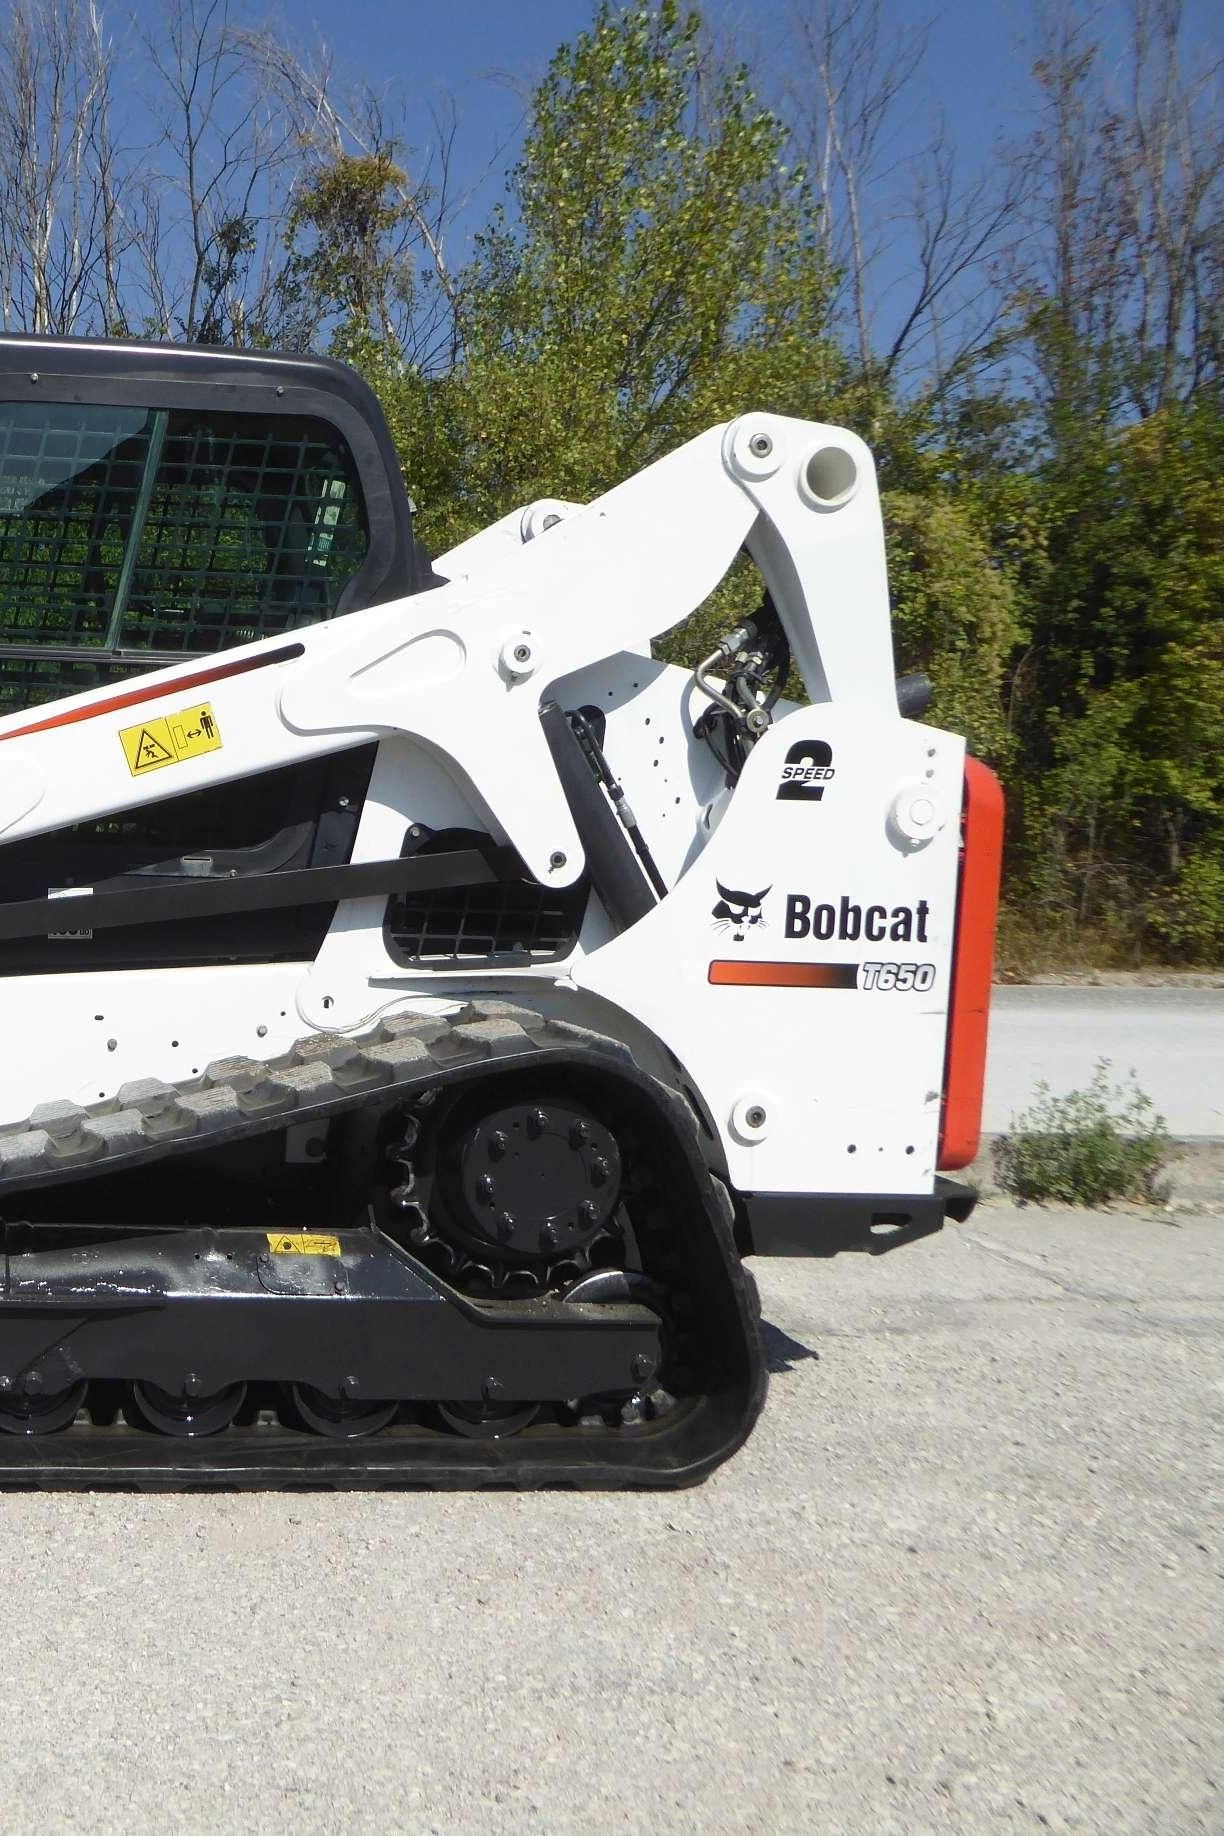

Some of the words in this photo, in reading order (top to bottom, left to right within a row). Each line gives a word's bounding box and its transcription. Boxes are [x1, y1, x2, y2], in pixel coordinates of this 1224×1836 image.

[776, 740, 832, 801] 2
[781, 767, 835, 780] SPEED
[784, 894, 929, 942] Bobcat
[863, 962, 936, 992] T650
